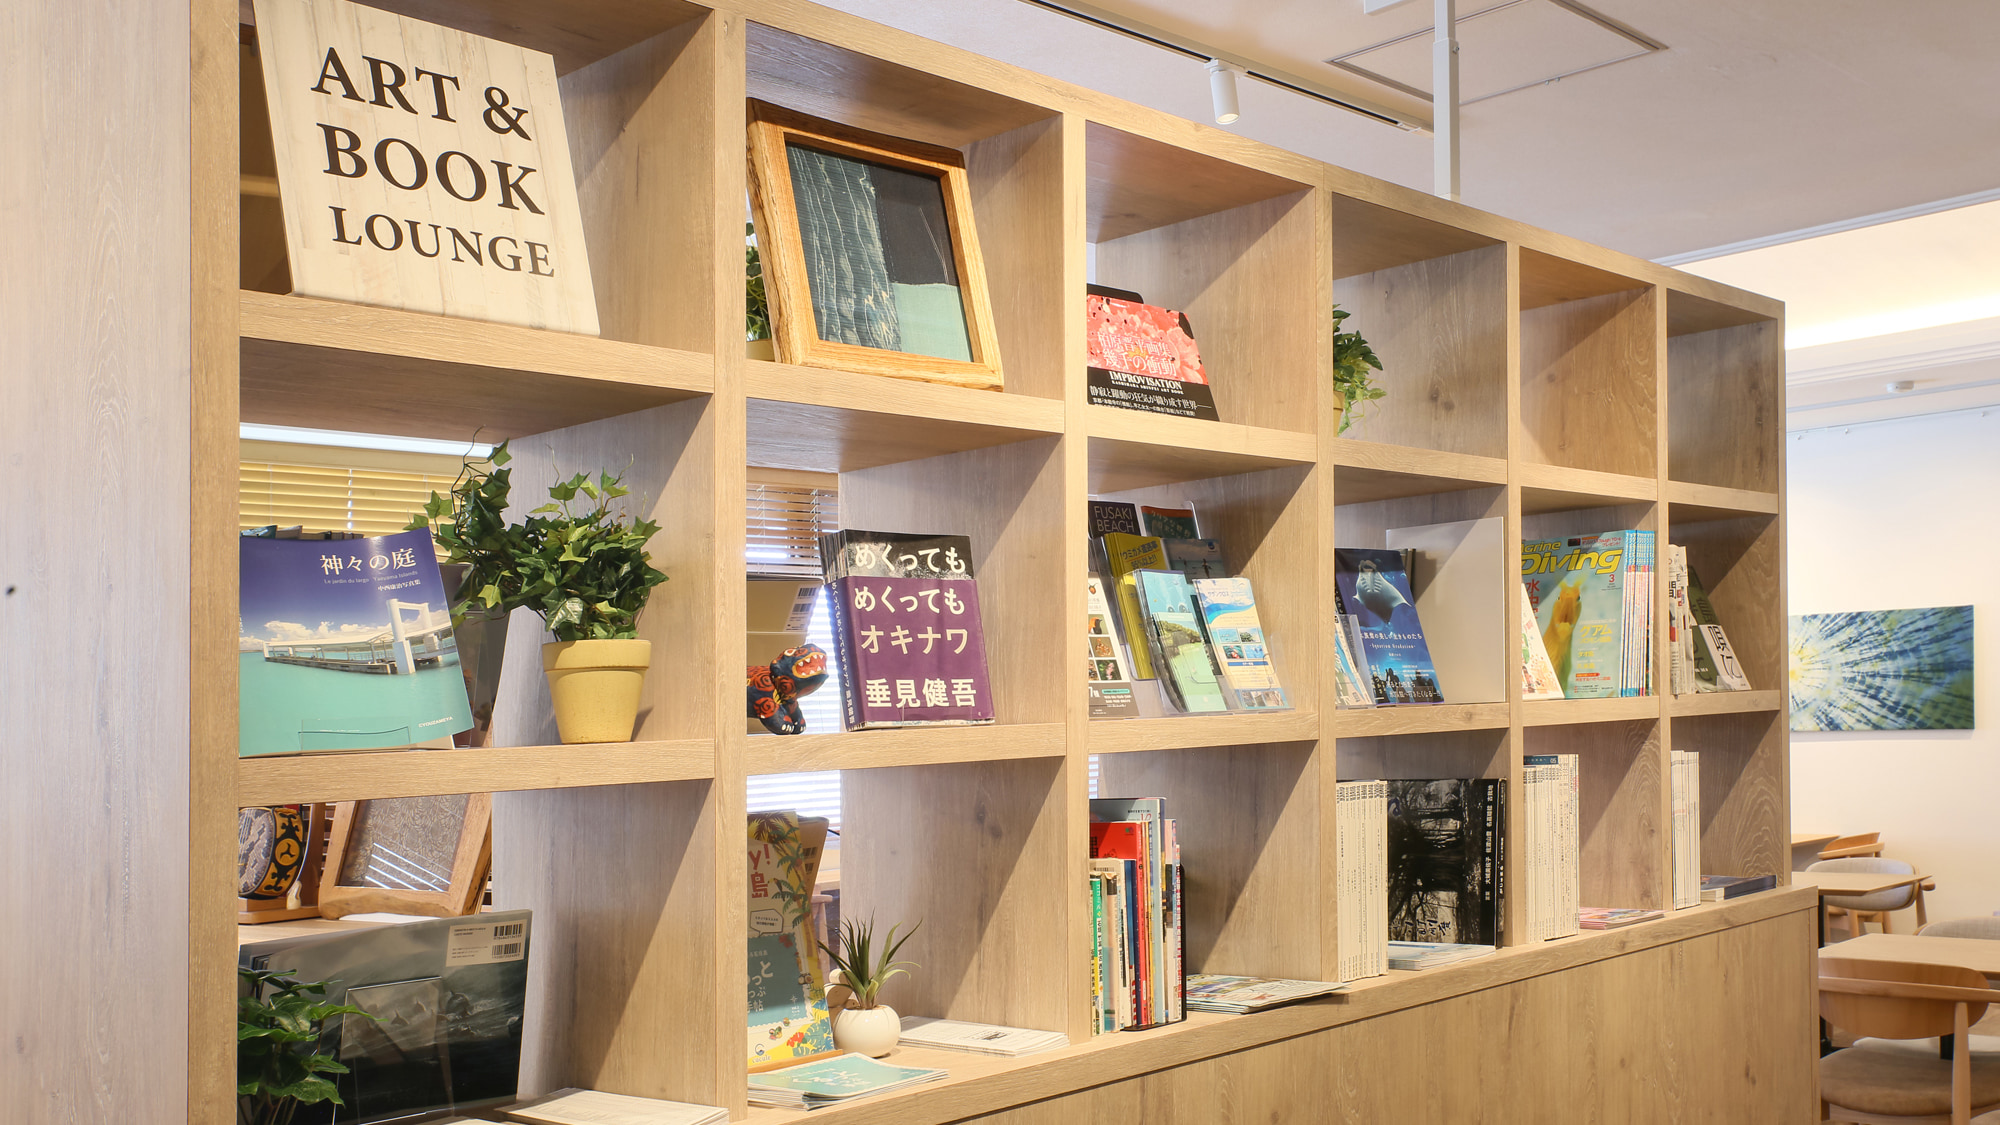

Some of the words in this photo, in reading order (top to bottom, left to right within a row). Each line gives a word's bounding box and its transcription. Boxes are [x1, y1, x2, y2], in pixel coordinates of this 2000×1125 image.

[310, 46, 460, 123] ART
[482, 86, 533, 141] &
[316, 122, 545, 216] BOOK
[328, 205, 555, 278] LOUNGE
[1108, 370, 1183, 391] IMPROVISATION
[1093, 505, 1133, 520] FUSAKI
[1096, 519, 1135, 533] BEACH
[319, 547, 416, 575] 神々の庭
[854, 544, 966, 574] めくっても
[1521, 541, 1561, 554] arine
[1521, 549, 1624, 575] Diving
[1609, 574, 1615, 583] 3
[854, 585, 965, 615] めくっても
[860, 625, 969, 655] オキナワ
[1580, 623, 1612, 638] グアム
[865, 677, 977, 708] 垂見健吾
[750, 871, 769, 899] 島
[751, 1054, 772, 1064] cucule
